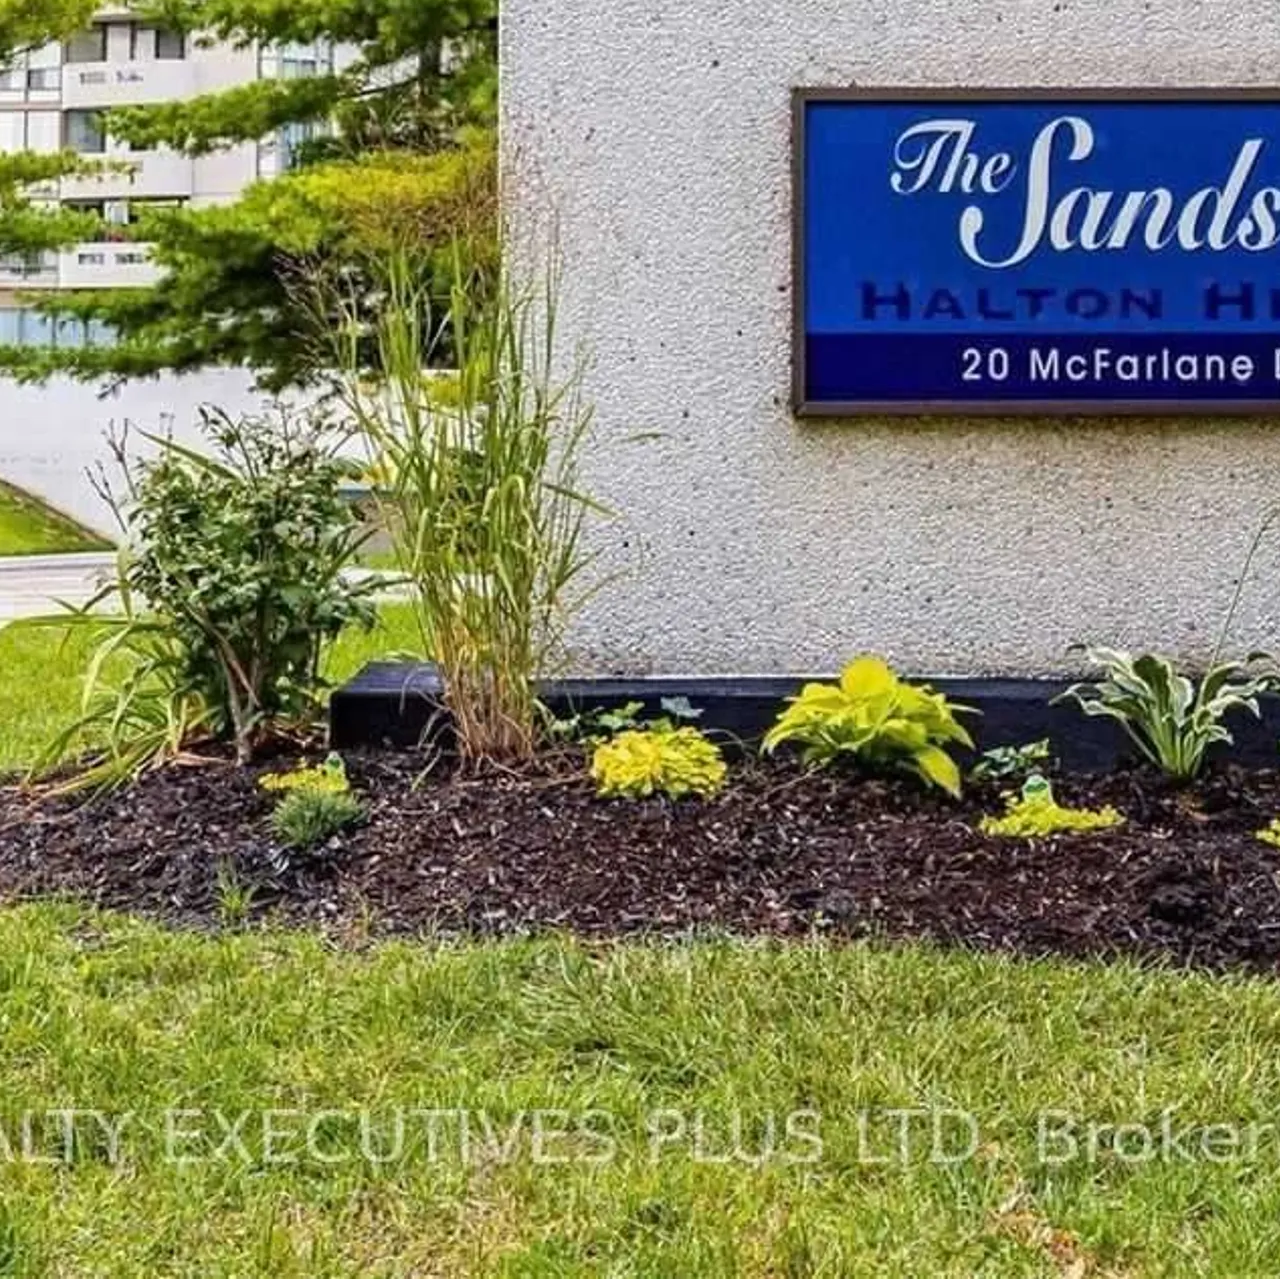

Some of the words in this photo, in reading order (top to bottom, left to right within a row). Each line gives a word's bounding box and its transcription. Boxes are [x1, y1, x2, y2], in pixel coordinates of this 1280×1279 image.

[890, 119, 1017, 194] The
[860, 280, 1164, 321] HALTON
[961, 347, 1010, 381] 20
[1029, 346, 1255, 381] McFarlane
